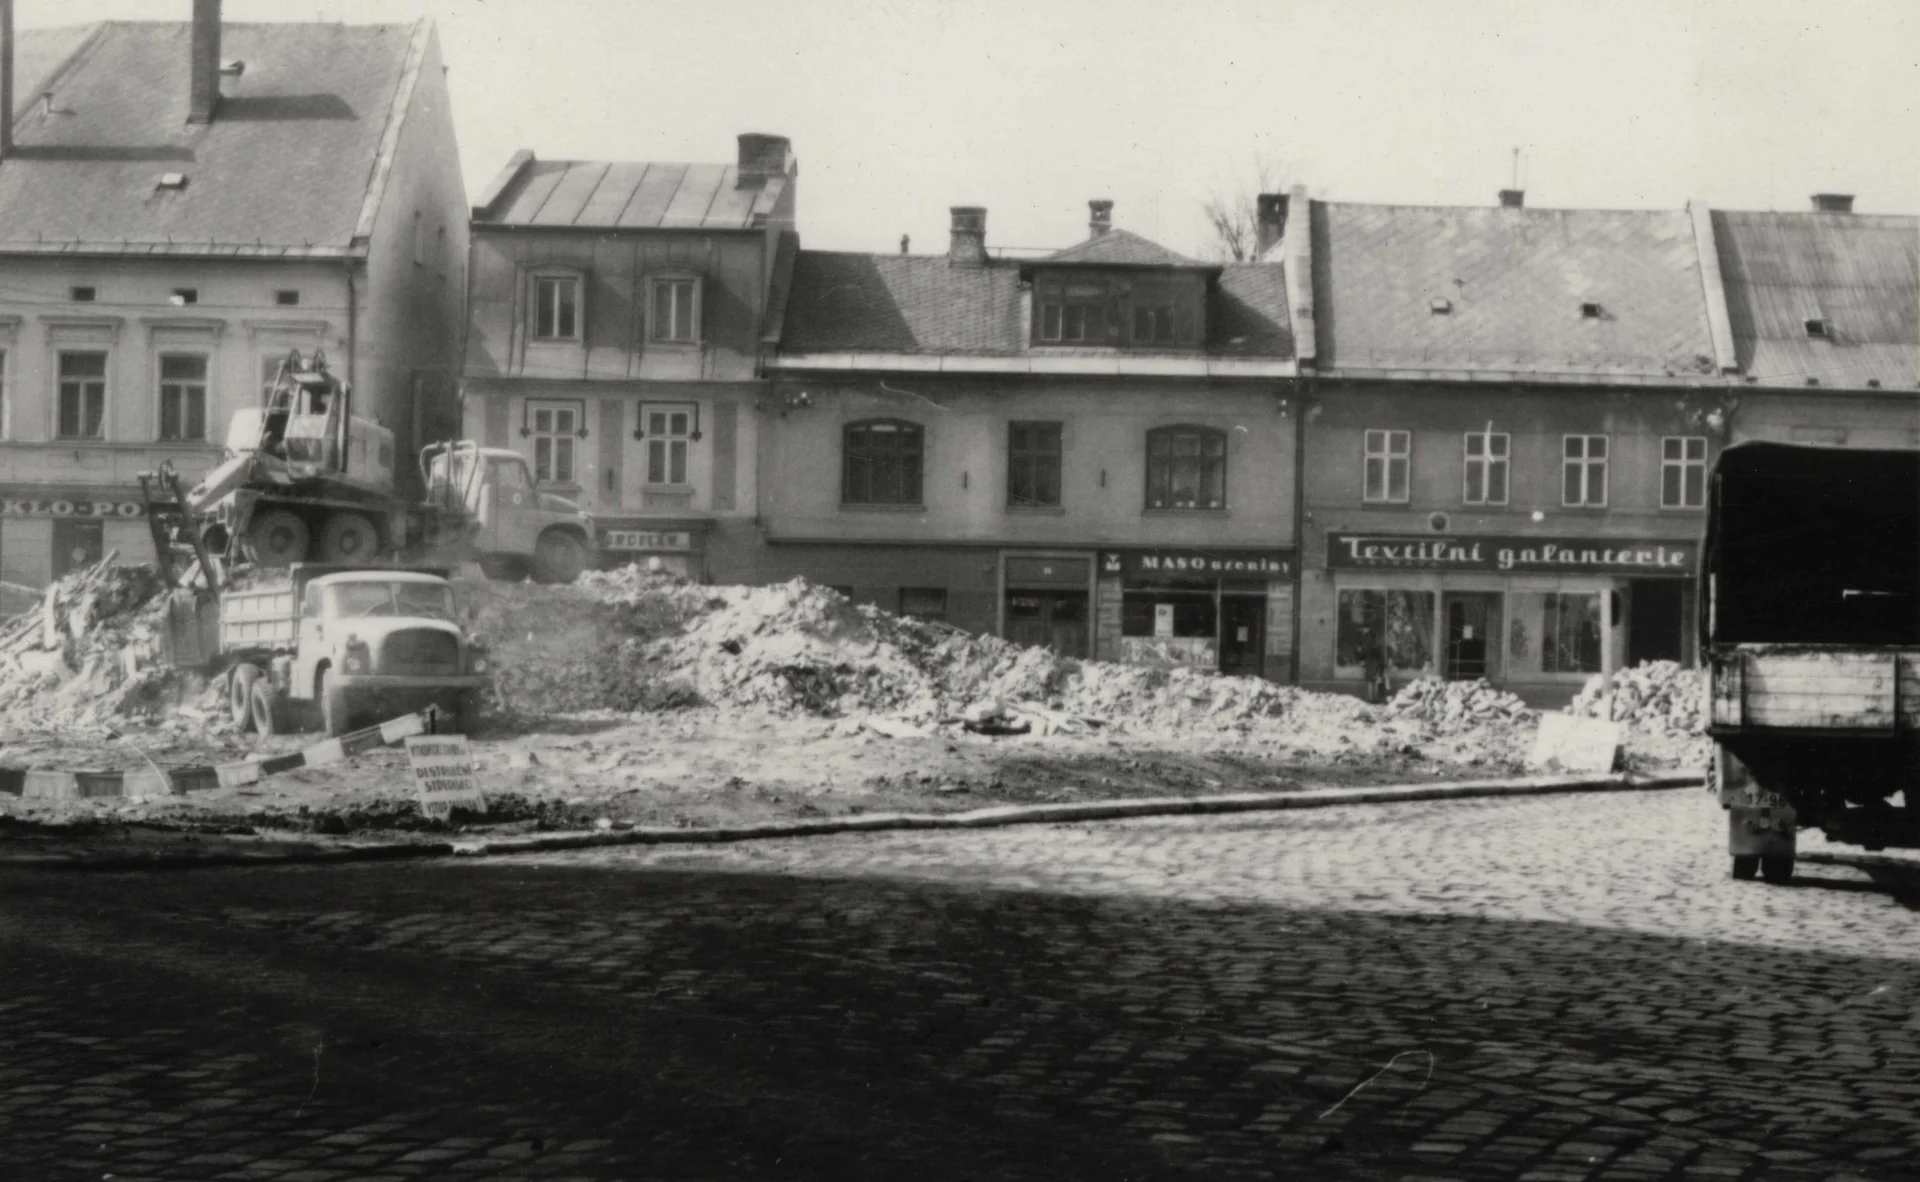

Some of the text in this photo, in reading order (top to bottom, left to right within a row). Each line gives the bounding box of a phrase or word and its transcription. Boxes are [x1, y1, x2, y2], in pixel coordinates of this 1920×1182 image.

[1141, 555, 1291, 574] MASO uzeniny
[1497, 543, 1685, 569] galanterie
